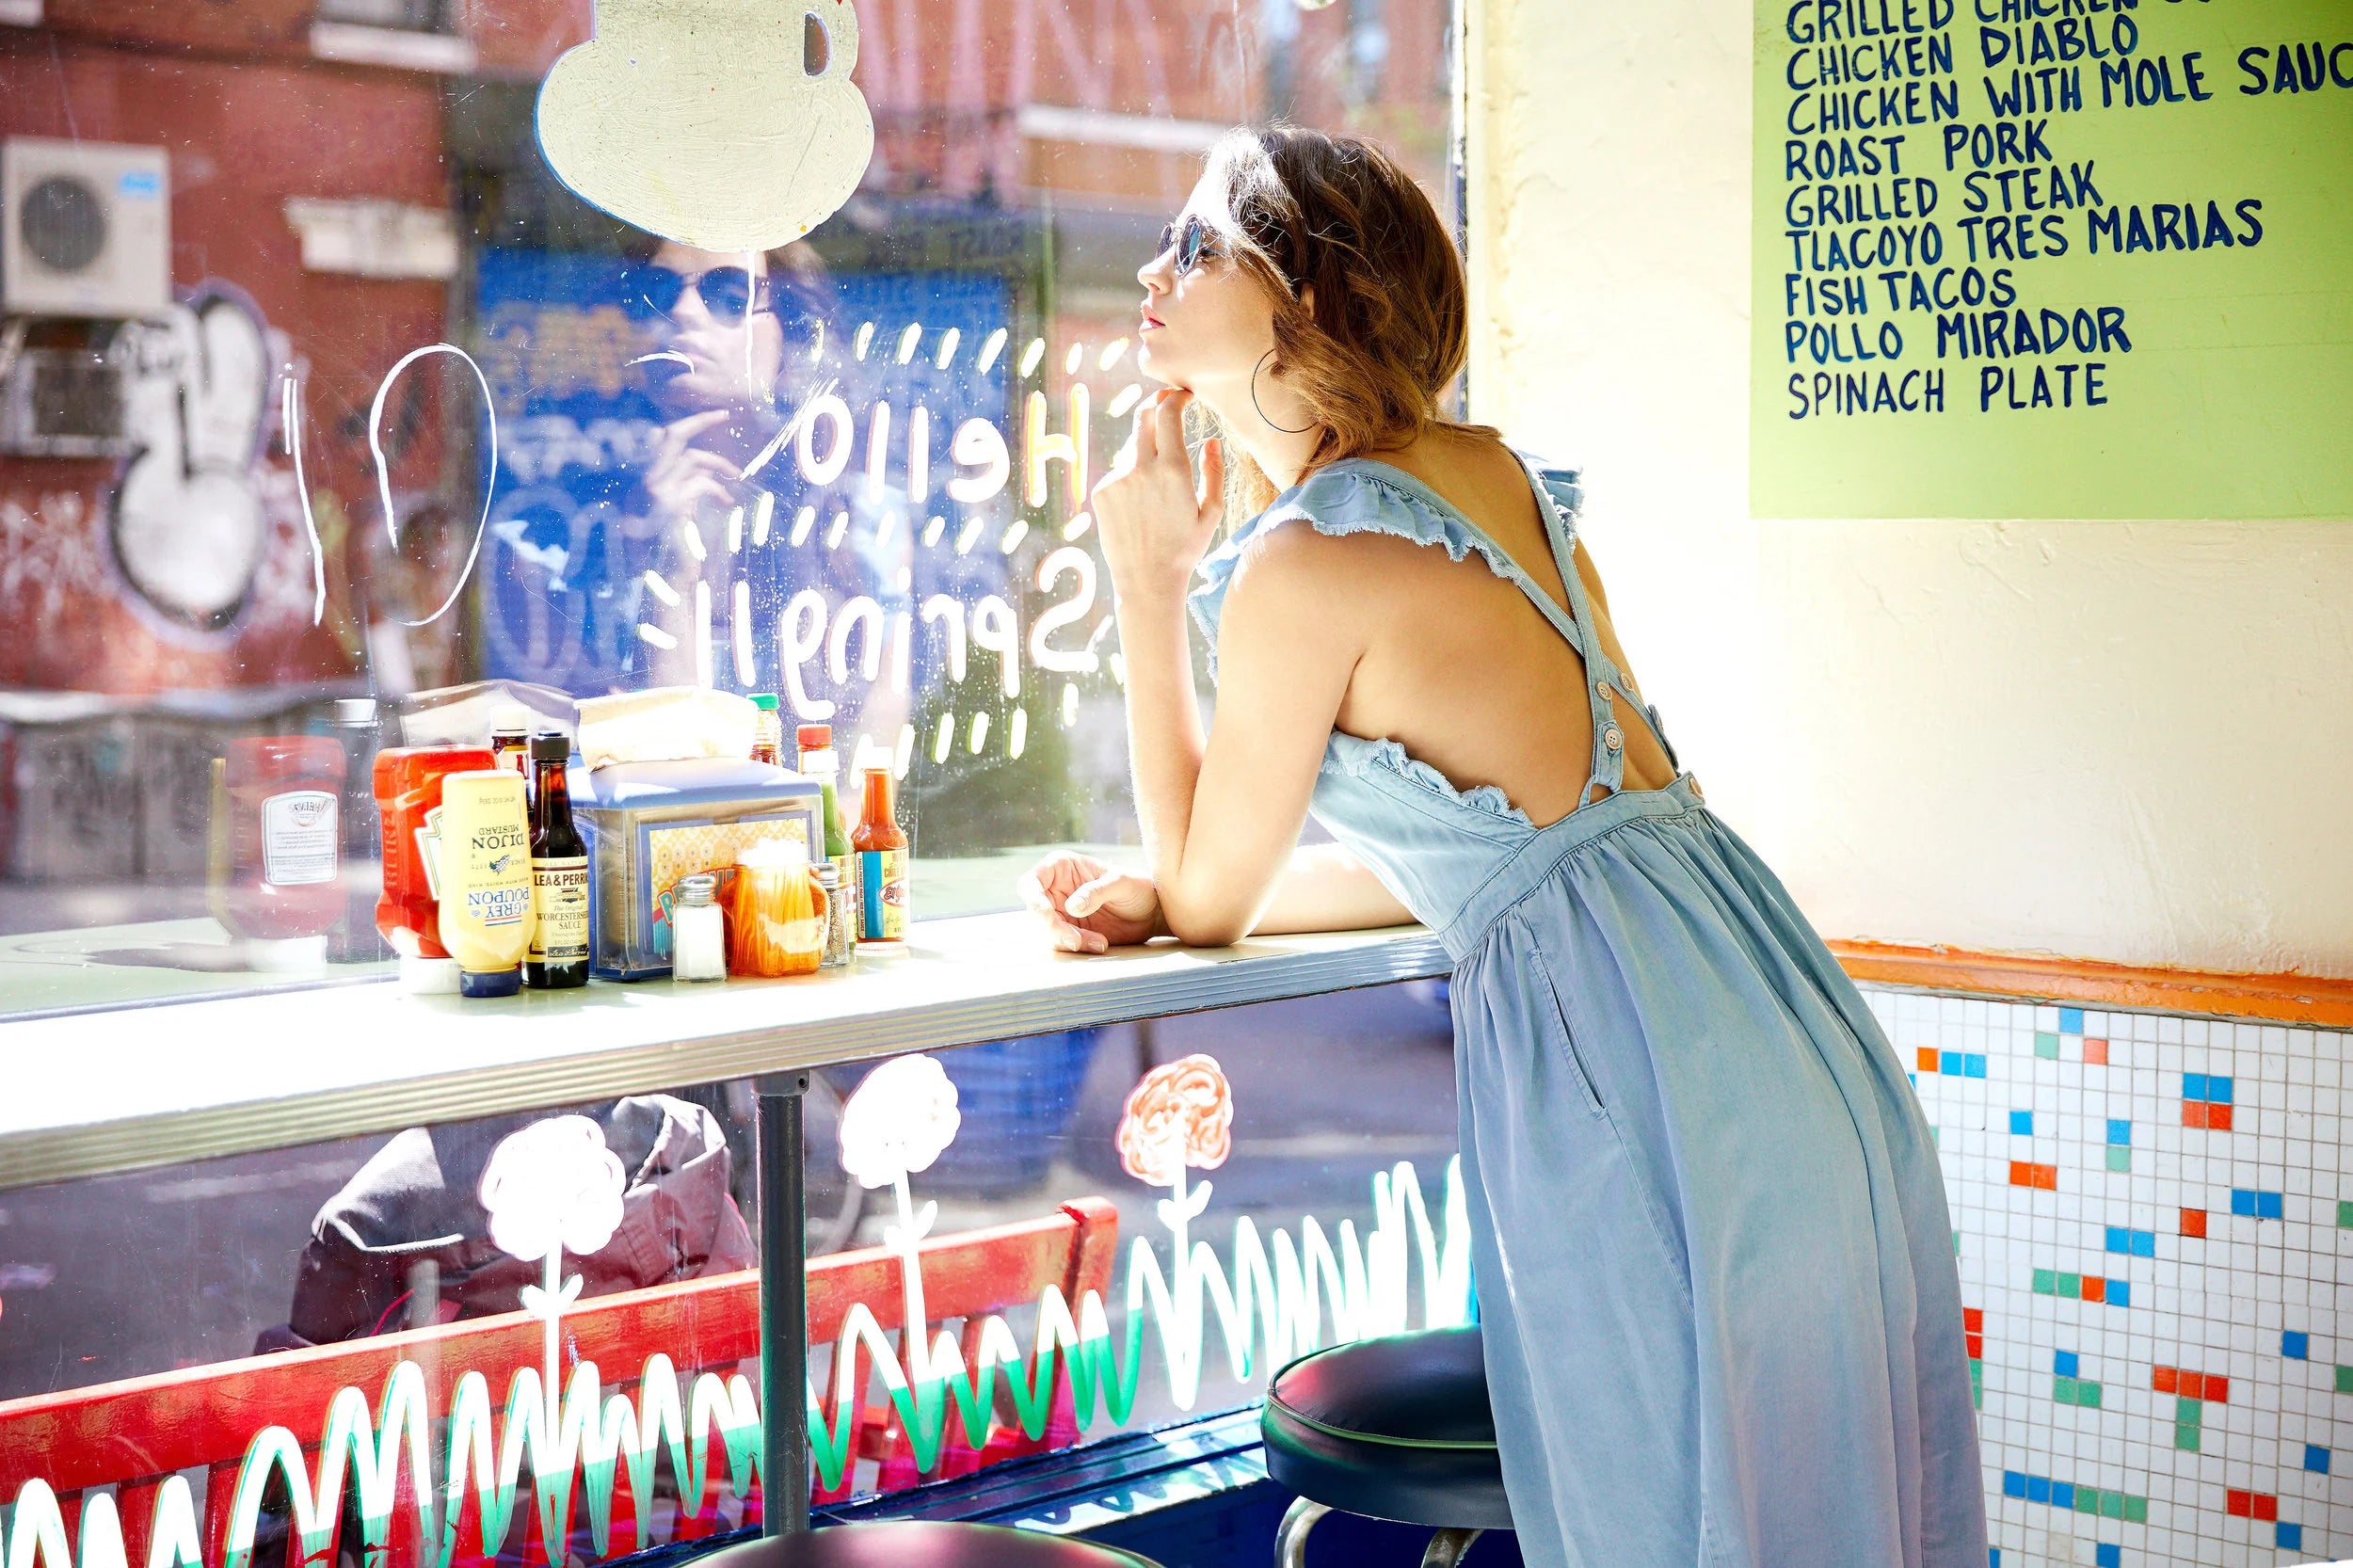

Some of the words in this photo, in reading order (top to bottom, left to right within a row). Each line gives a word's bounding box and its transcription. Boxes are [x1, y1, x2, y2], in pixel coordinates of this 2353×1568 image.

[1785, 0, 1955, 44] GRILLED
[1786, 31, 1953, 91] CHICKEN
[1979, 12, 2138, 69] DIABLO
[1787, 79, 1960, 136] CHICKEN
[1982, 65, 2083, 119] WITH
[2100, 51, 2215, 108] MOLE
[1785, 135, 1906, 182] ROAST
[1943, 118, 2053, 172] PORK
[1785, 177, 1938, 228] GRILLED
[1962, 159, 2104, 213] STEAK
[1785, 221, 1943, 272] TLACOYO
[1956, 214, 2069, 264] TRES
[2087, 199, 2264, 255] MARIAS
[1785, 275, 1868, 317] FISH
[1878, 265, 2017, 313] TACOS
[1785, 320, 1903, 365] POLLO
[1936, 306, 2133, 360] MIRADOR
[1788, 369, 1945, 420] SPINACH
[1980, 362, 2108, 413] PLATE
[472, 832, 524, 850] DIJON
[478, 824, 520, 836] MUSTARD
[468, 887, 530, 906] POUPON
[534, 873, 552, 887] LEA
[552, 874, 562, 886] &
[485, 902, 522, 919] GREY
[558, 920, 581, 930] SAUCE
